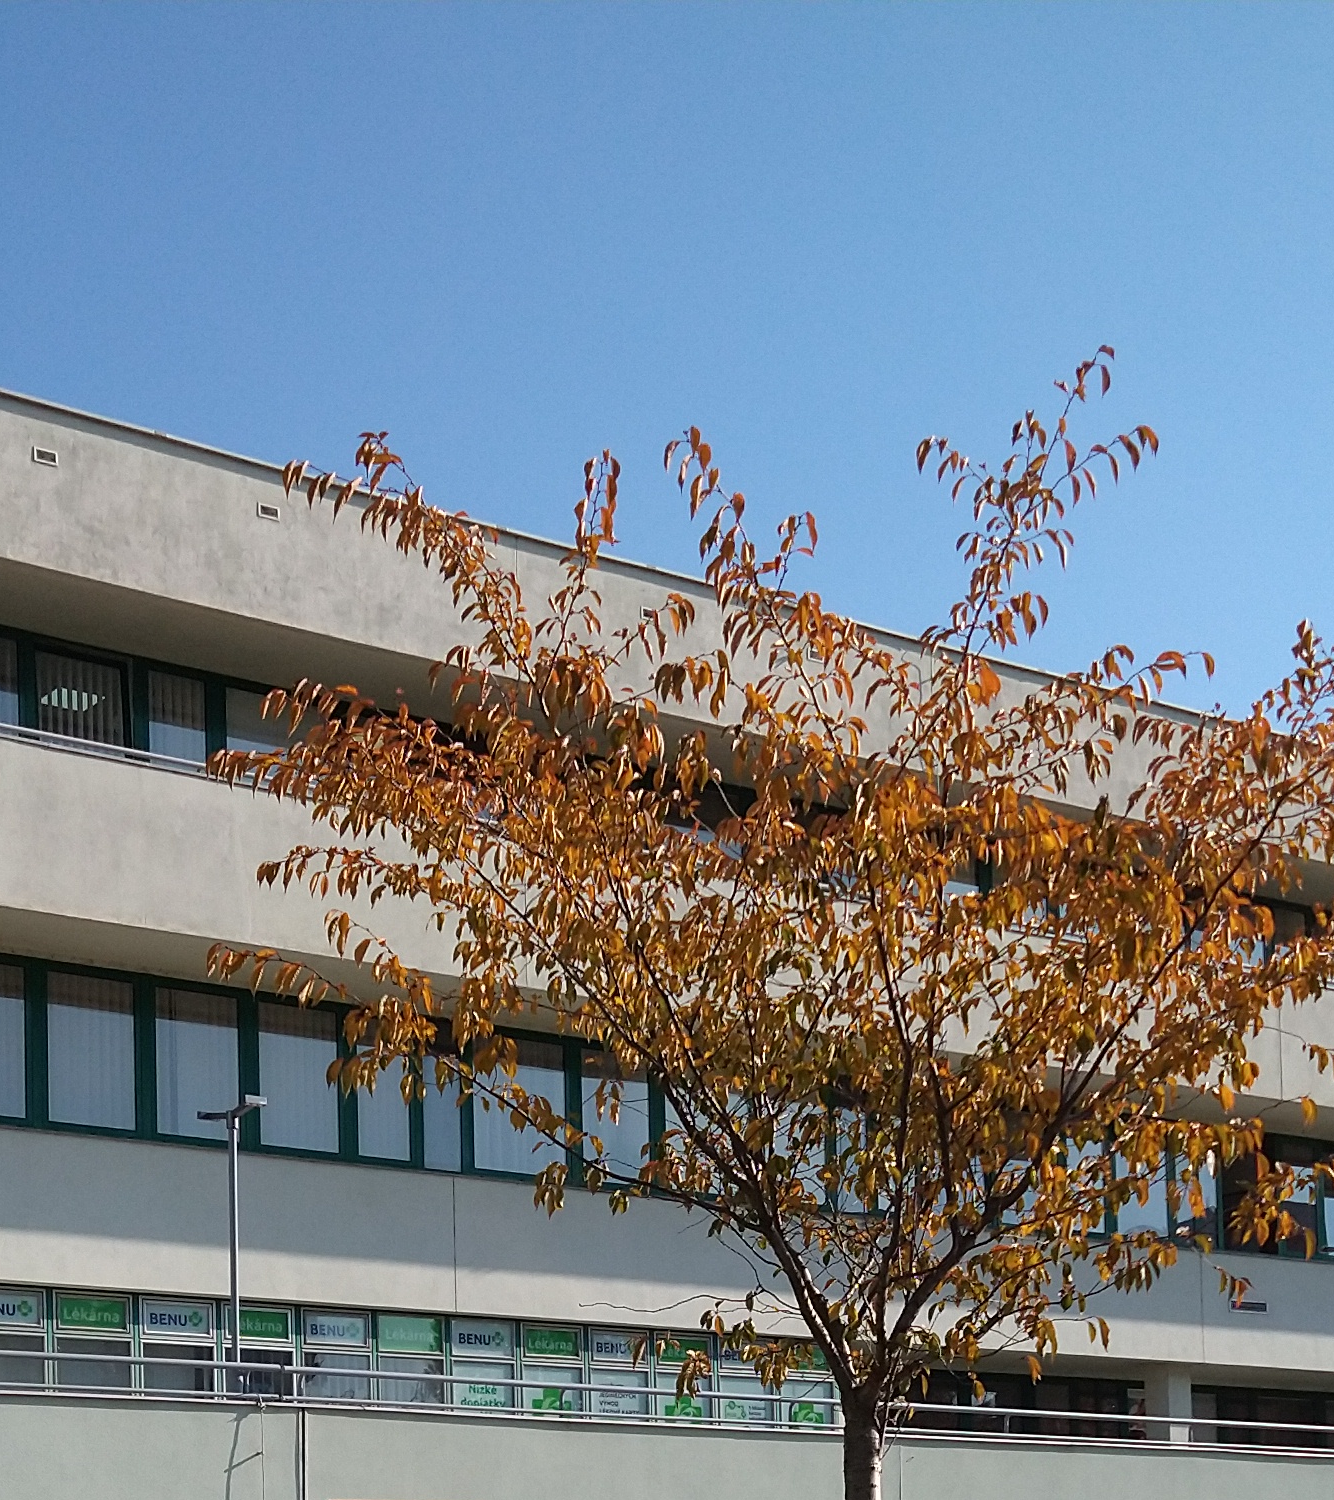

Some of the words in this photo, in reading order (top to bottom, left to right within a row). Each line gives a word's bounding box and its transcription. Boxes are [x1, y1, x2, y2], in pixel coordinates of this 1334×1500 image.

[63, 1306, 120, 1323] Lékárna
[149, 1312, 188, 1327] BENU
[240, 1316, 283, 1333] ékárna
[310, 1323, 345, 1337] BENU
[458, 1332, 491, 1346] BENU
[528, 1338, 573, 1352] Lékárna
